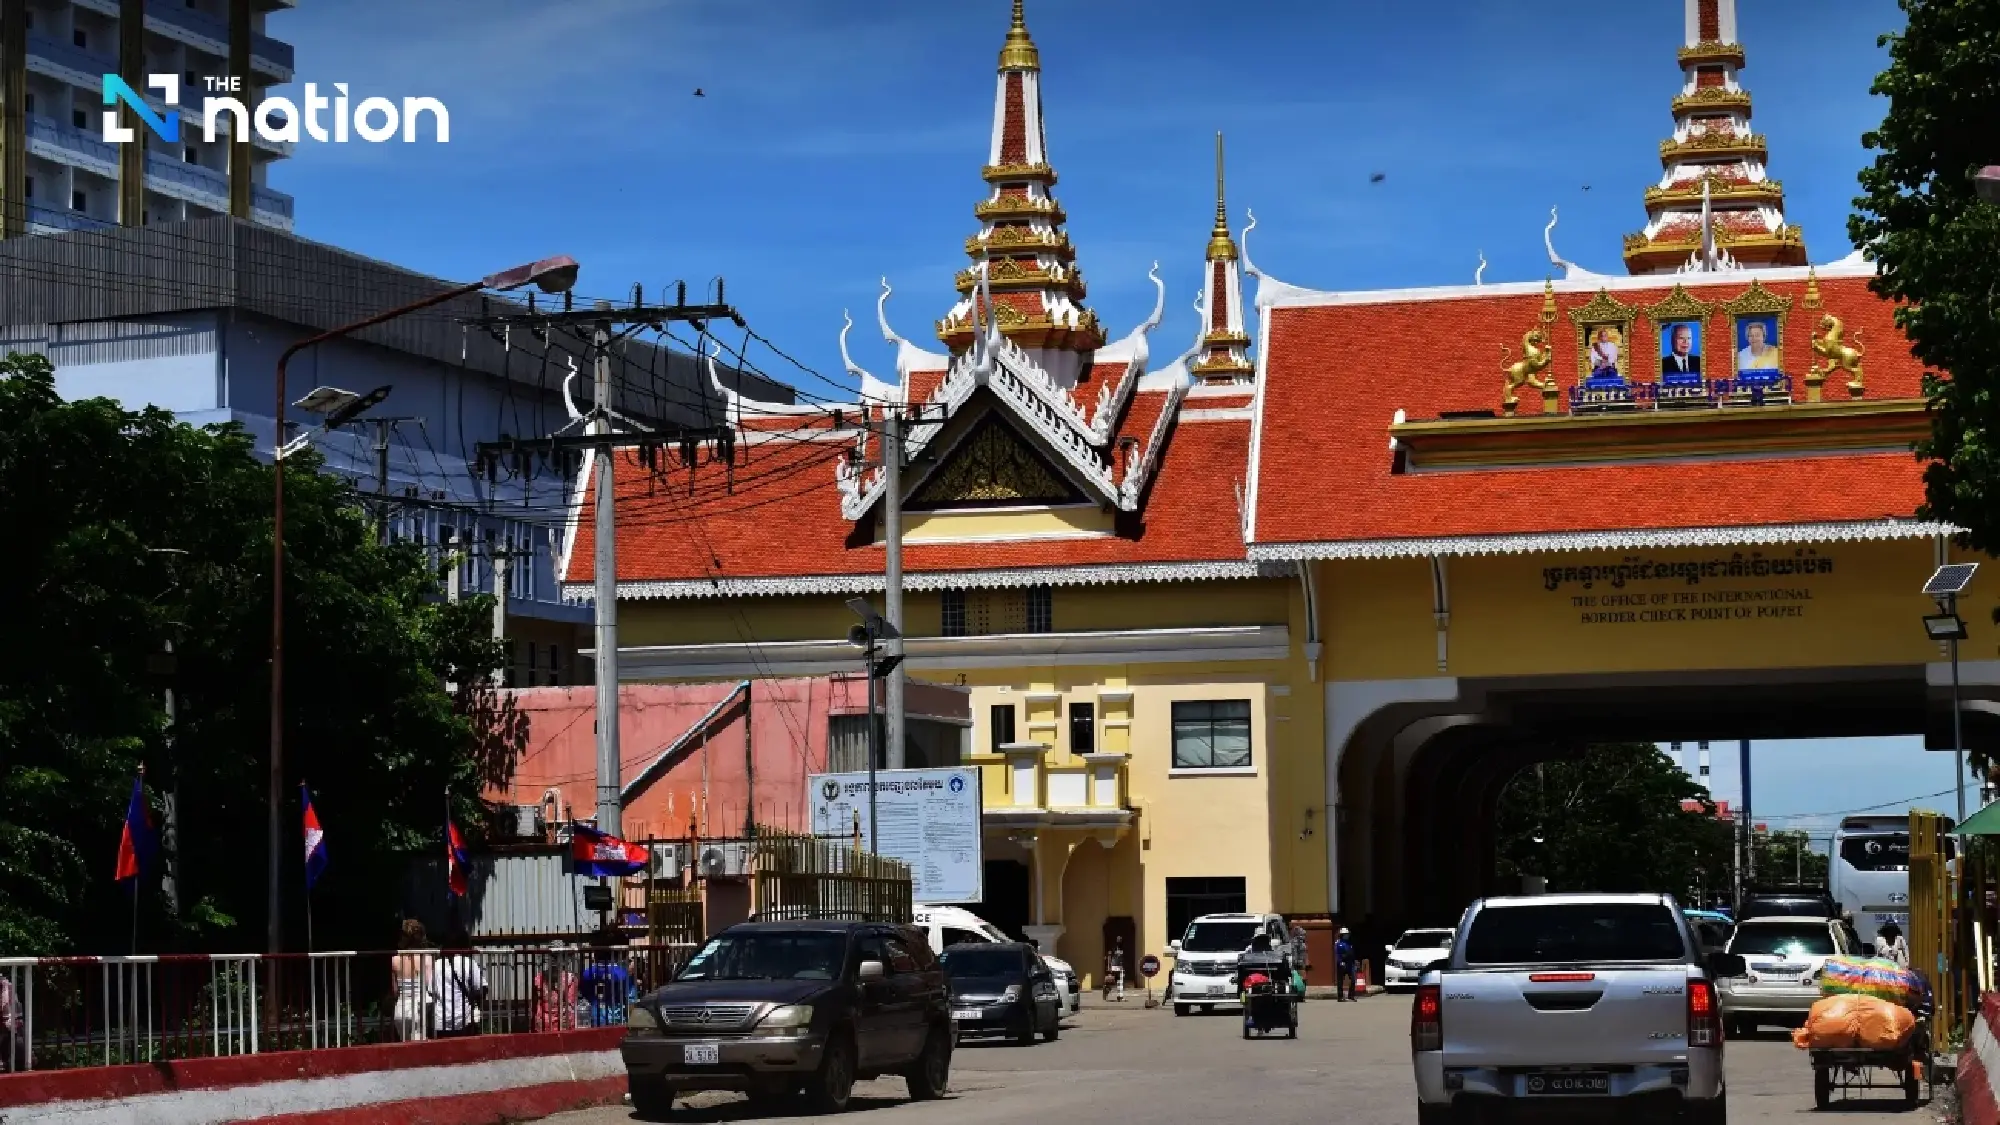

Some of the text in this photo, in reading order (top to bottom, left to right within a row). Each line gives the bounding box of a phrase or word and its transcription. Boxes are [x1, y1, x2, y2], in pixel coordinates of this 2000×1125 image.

[1571, 588, 1813, 607] THE OFFICE OF THE INTERNATIONAL
[1581, 605, 1804, 624] BORDER CHECK POINT OF POIPET
